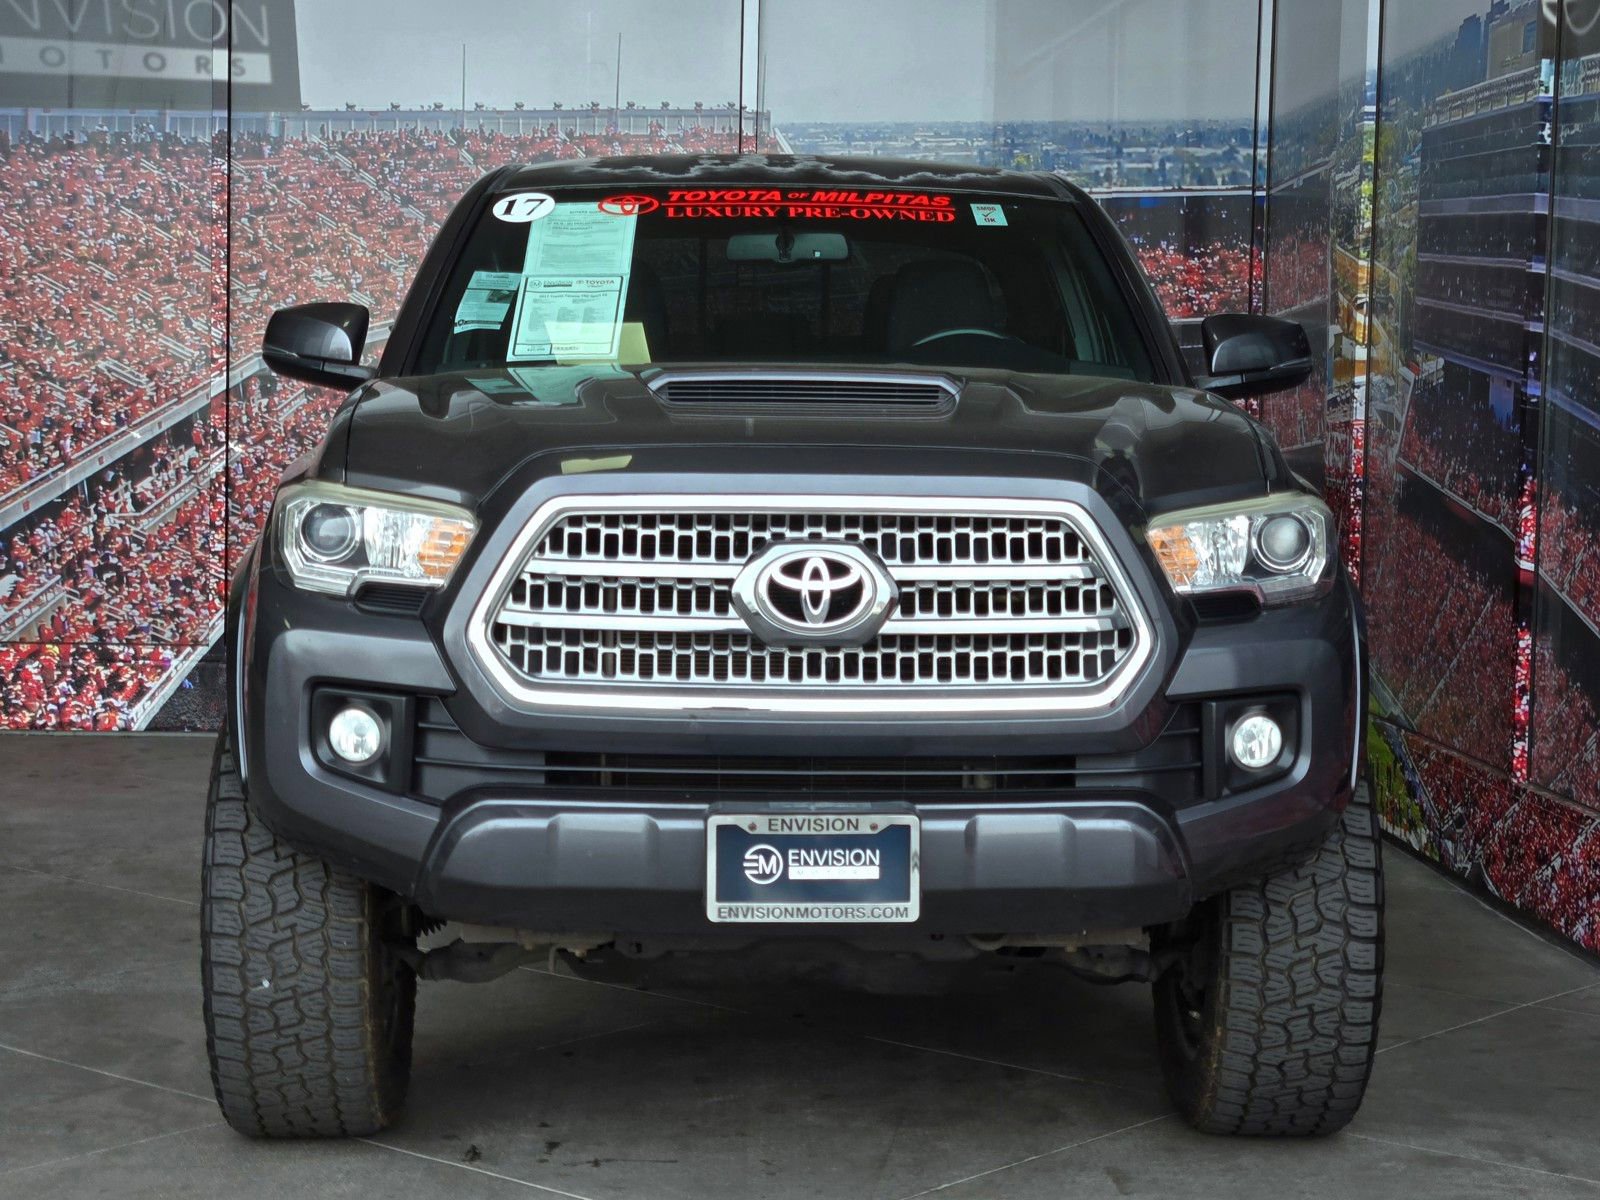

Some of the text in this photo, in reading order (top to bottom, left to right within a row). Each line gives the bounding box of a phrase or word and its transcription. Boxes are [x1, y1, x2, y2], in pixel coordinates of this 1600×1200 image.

[0, 46, 247, 77] OTORS
[667, 190, 951, 206] TOYOTA OF MILPITAS
[500, 198, 548, 216] 17
[666, 206, 956, 222] LUXURY PRE-OWNED
[767, 818, 860, 833] ENVISION
[788, 849, 880, 866] ENVISION
[717, 906, 909, 920] ENVISIONMOTORS.COM
